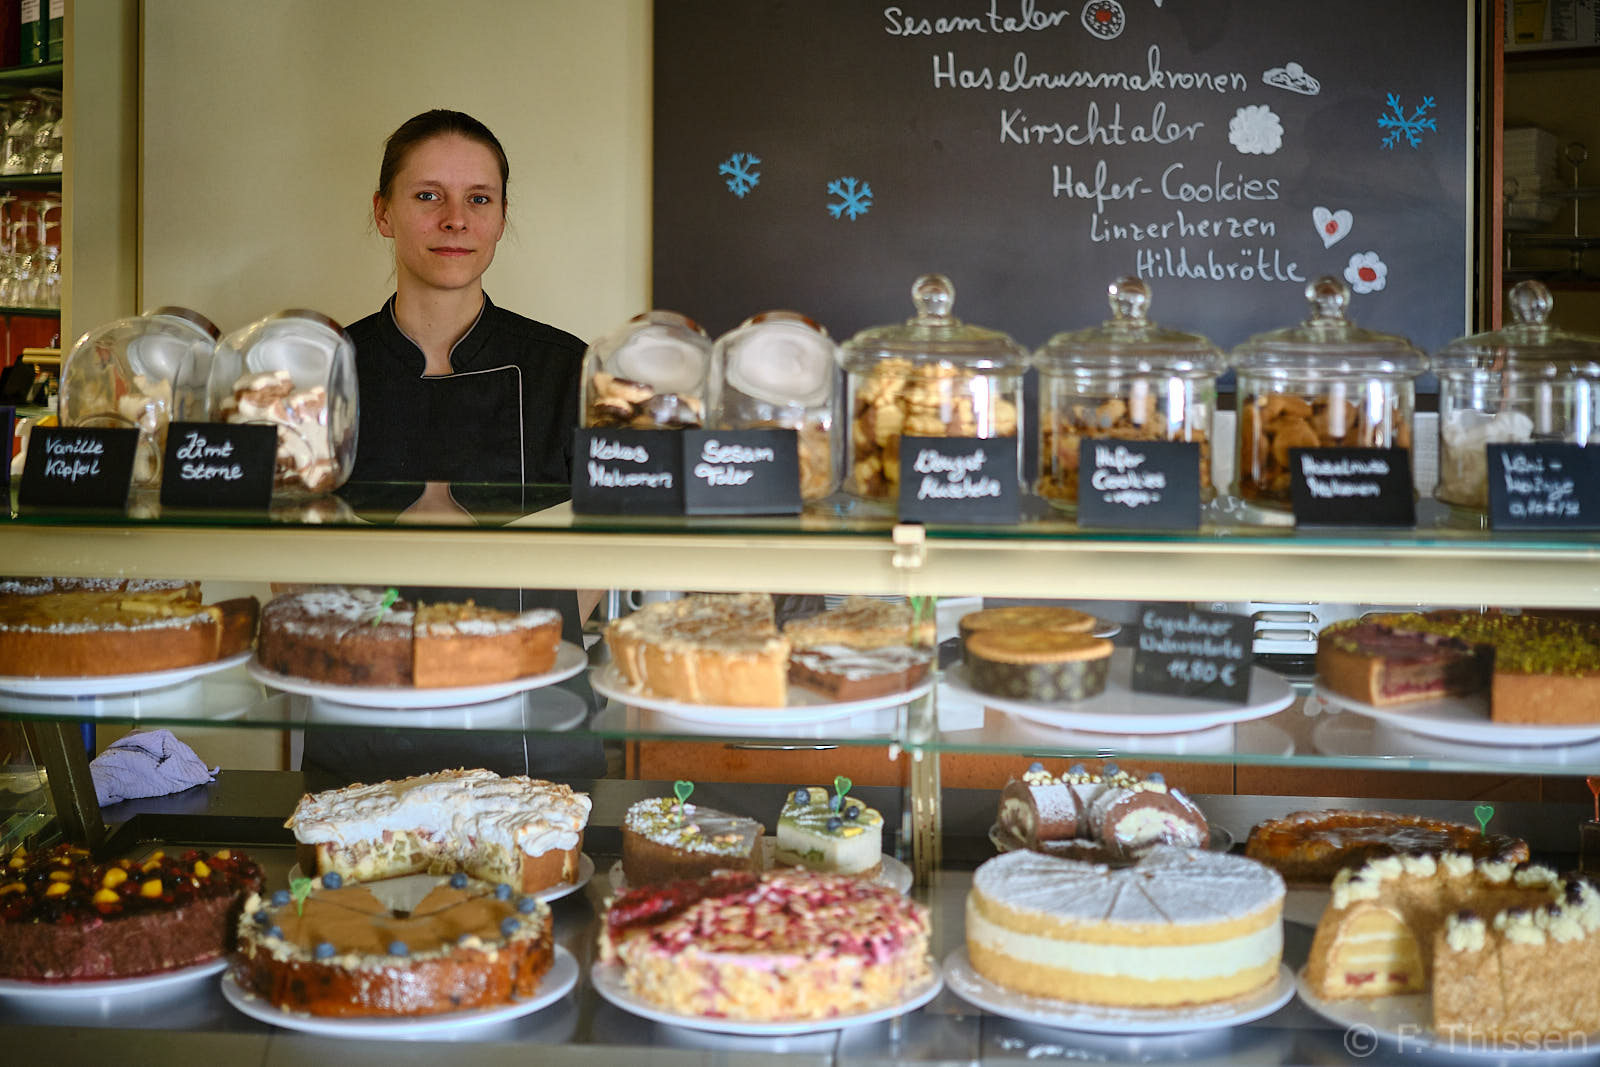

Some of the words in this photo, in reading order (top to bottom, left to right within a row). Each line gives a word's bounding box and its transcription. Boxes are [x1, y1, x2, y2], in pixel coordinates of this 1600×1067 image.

[884, 0, 1070, 36] Sesamtaler
[933, 45, 1247, 92] Haselnussmakronen
[1000, 101, 1205, 145] Kirschtaler
[1053, 160, 1280, 213] Hafer-Cookies
[1136, 248, 1306, 283] Hildabrötle
[45, 437, 104, 454] Vanille
[702, 439, 774, 463] Sesam
[181, 463, 244, 480] Sterne
